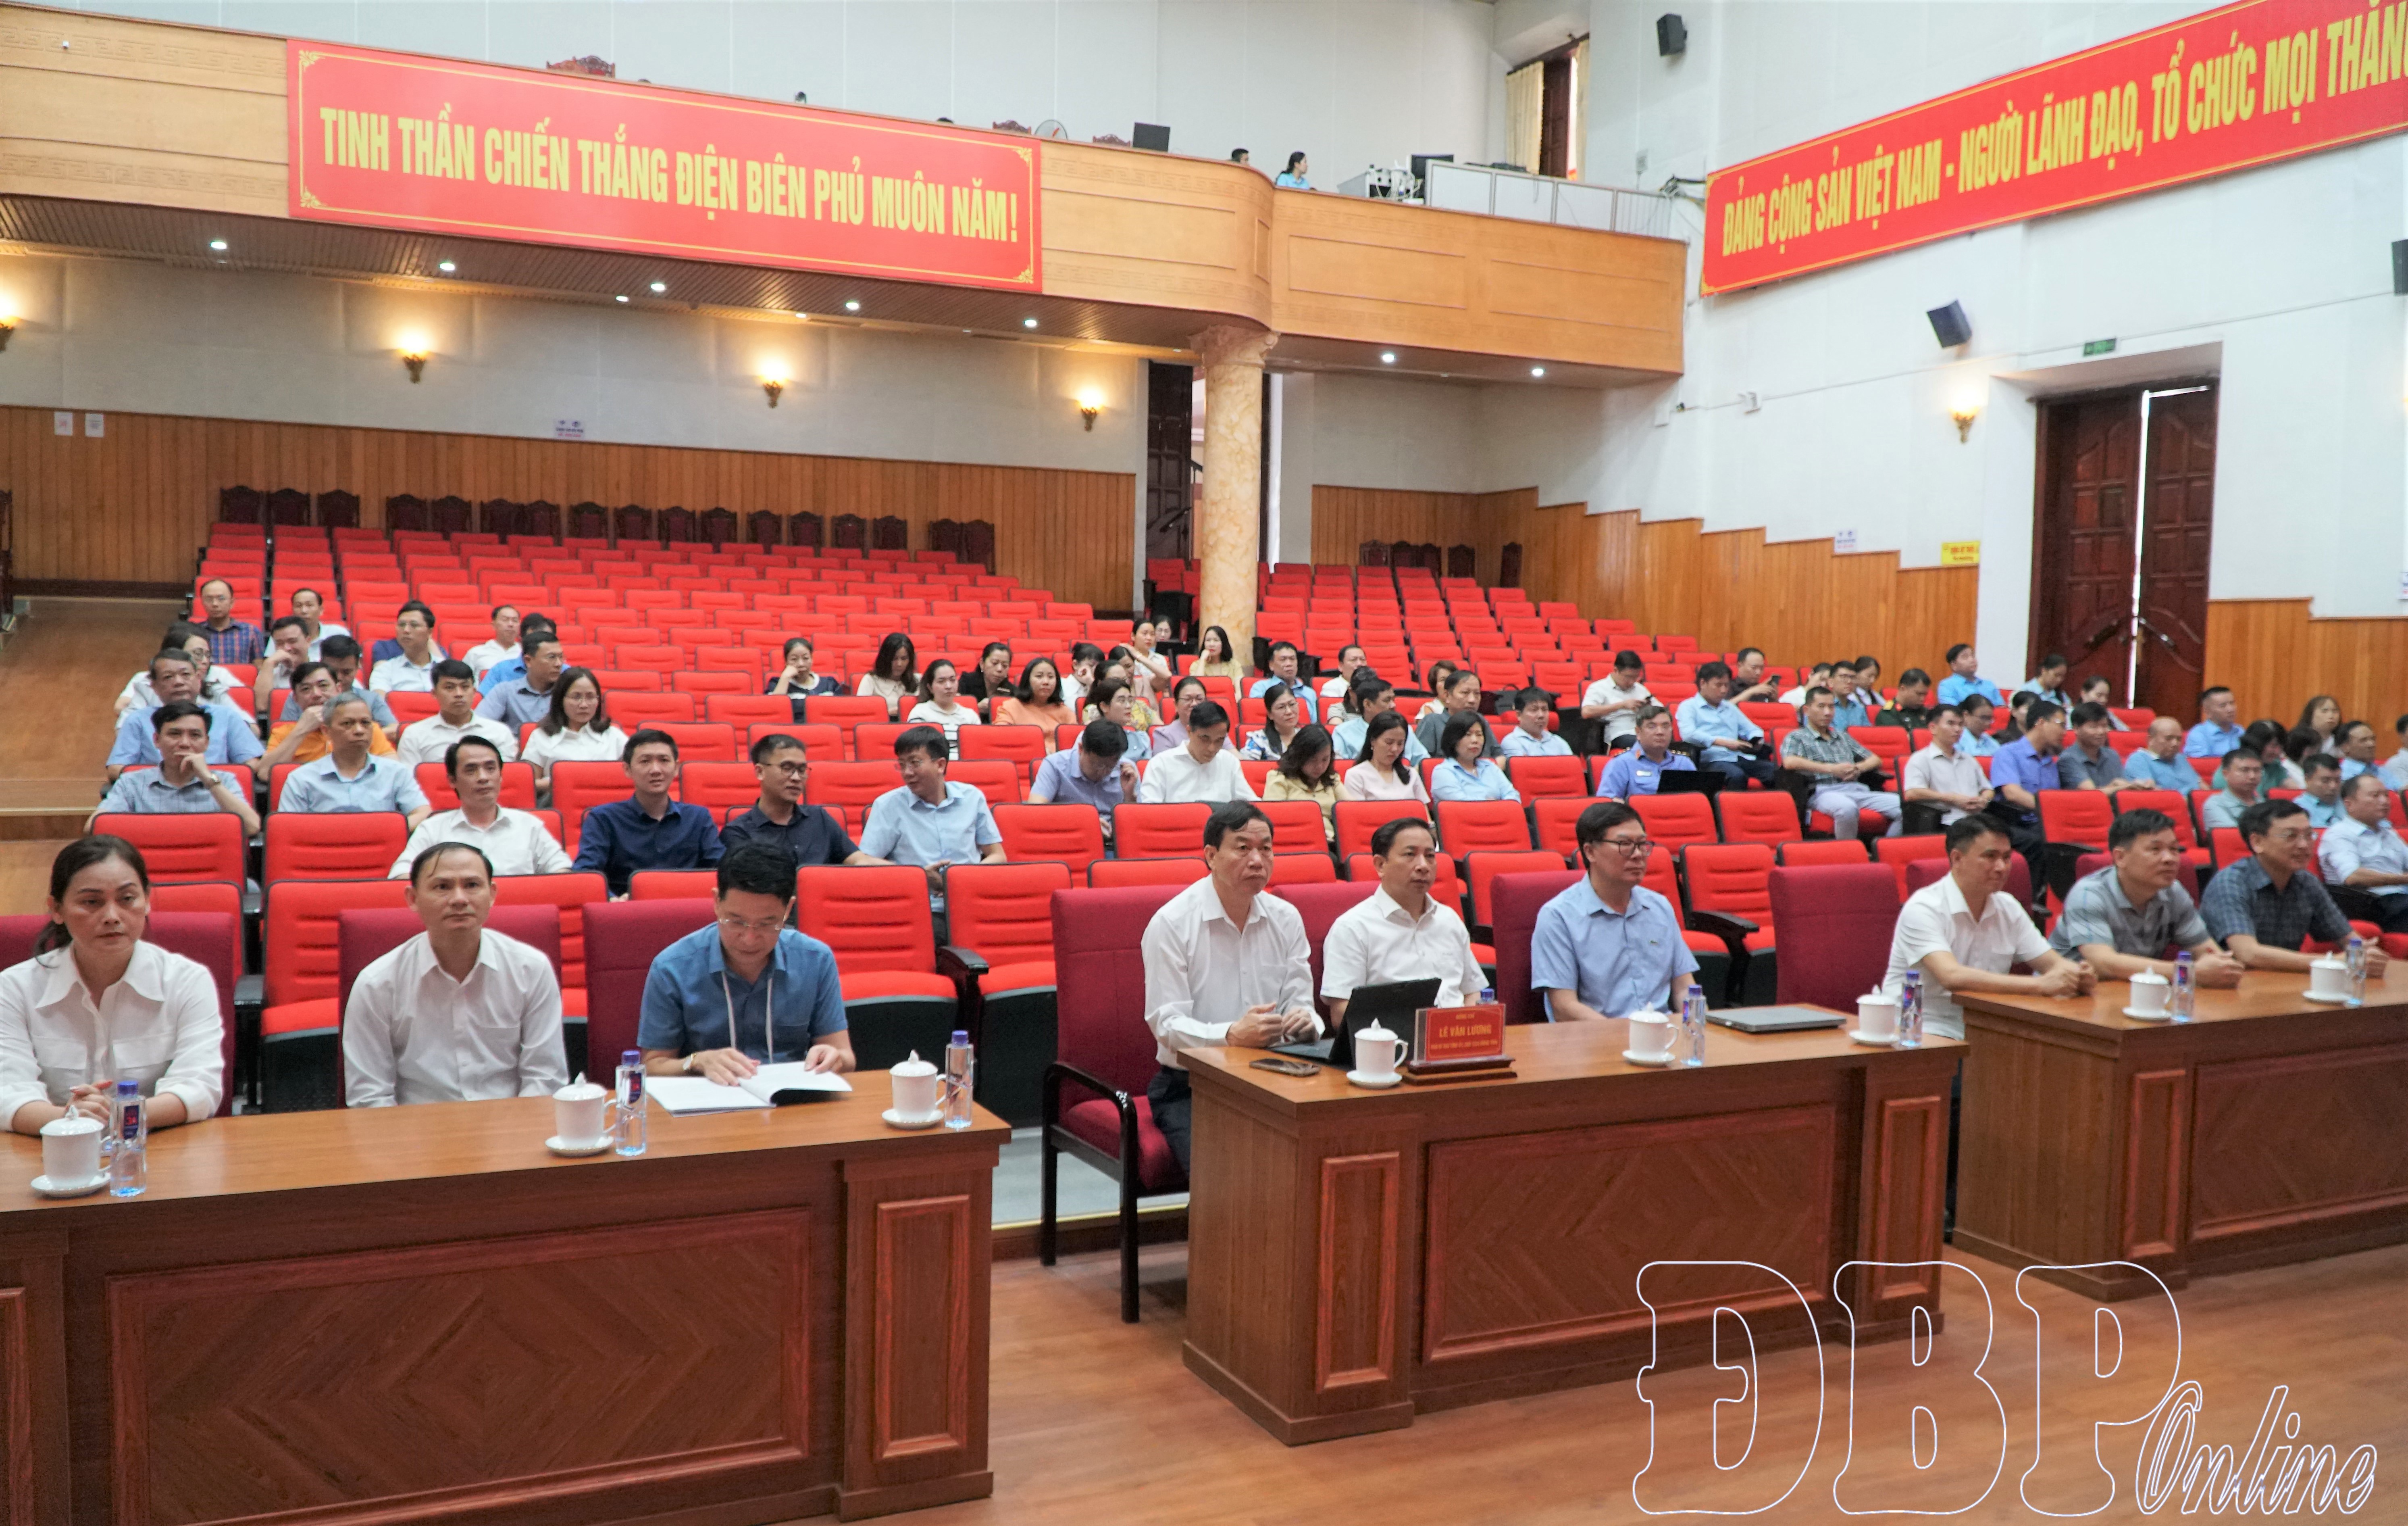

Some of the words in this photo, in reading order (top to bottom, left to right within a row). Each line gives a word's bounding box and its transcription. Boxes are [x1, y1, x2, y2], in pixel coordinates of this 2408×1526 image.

[320, 106, 390, 172] TINH
[397, 100, 476, 181] THẦN
[484, 116, 570, 192] CHIẾN
[577, 122, 668, 203] THẮNG
[675, 143, 739, 221] ĐIỆN
[746, 152, 807, 219] BIÊN
[814, 155, 865, 226] PHỦ
[872, 169, 945, 235] MUÔN
[952, 177, 1018, 243] NĂM!
[1722, 175, 1766, 257] ĐẢNG
[1768, 173, 1813, 254] CỘNG
[1815, 145, 1853, 232] SẢN
[1856, 144, 1894, 230] VIỆT
[1896, 138, 1942, 210] NAM
[1958, 100, 2023, 193] NGƯỜI
[2026, 92, 2086, 176] LÃNH
[2090, 81, 2144, 171] ĐẠO,
[2152, 38, 2184, 143] TỔ
[2187, 30, 2257, 134] CHỨC
[2263, 27, 2319, 124] MỌI
